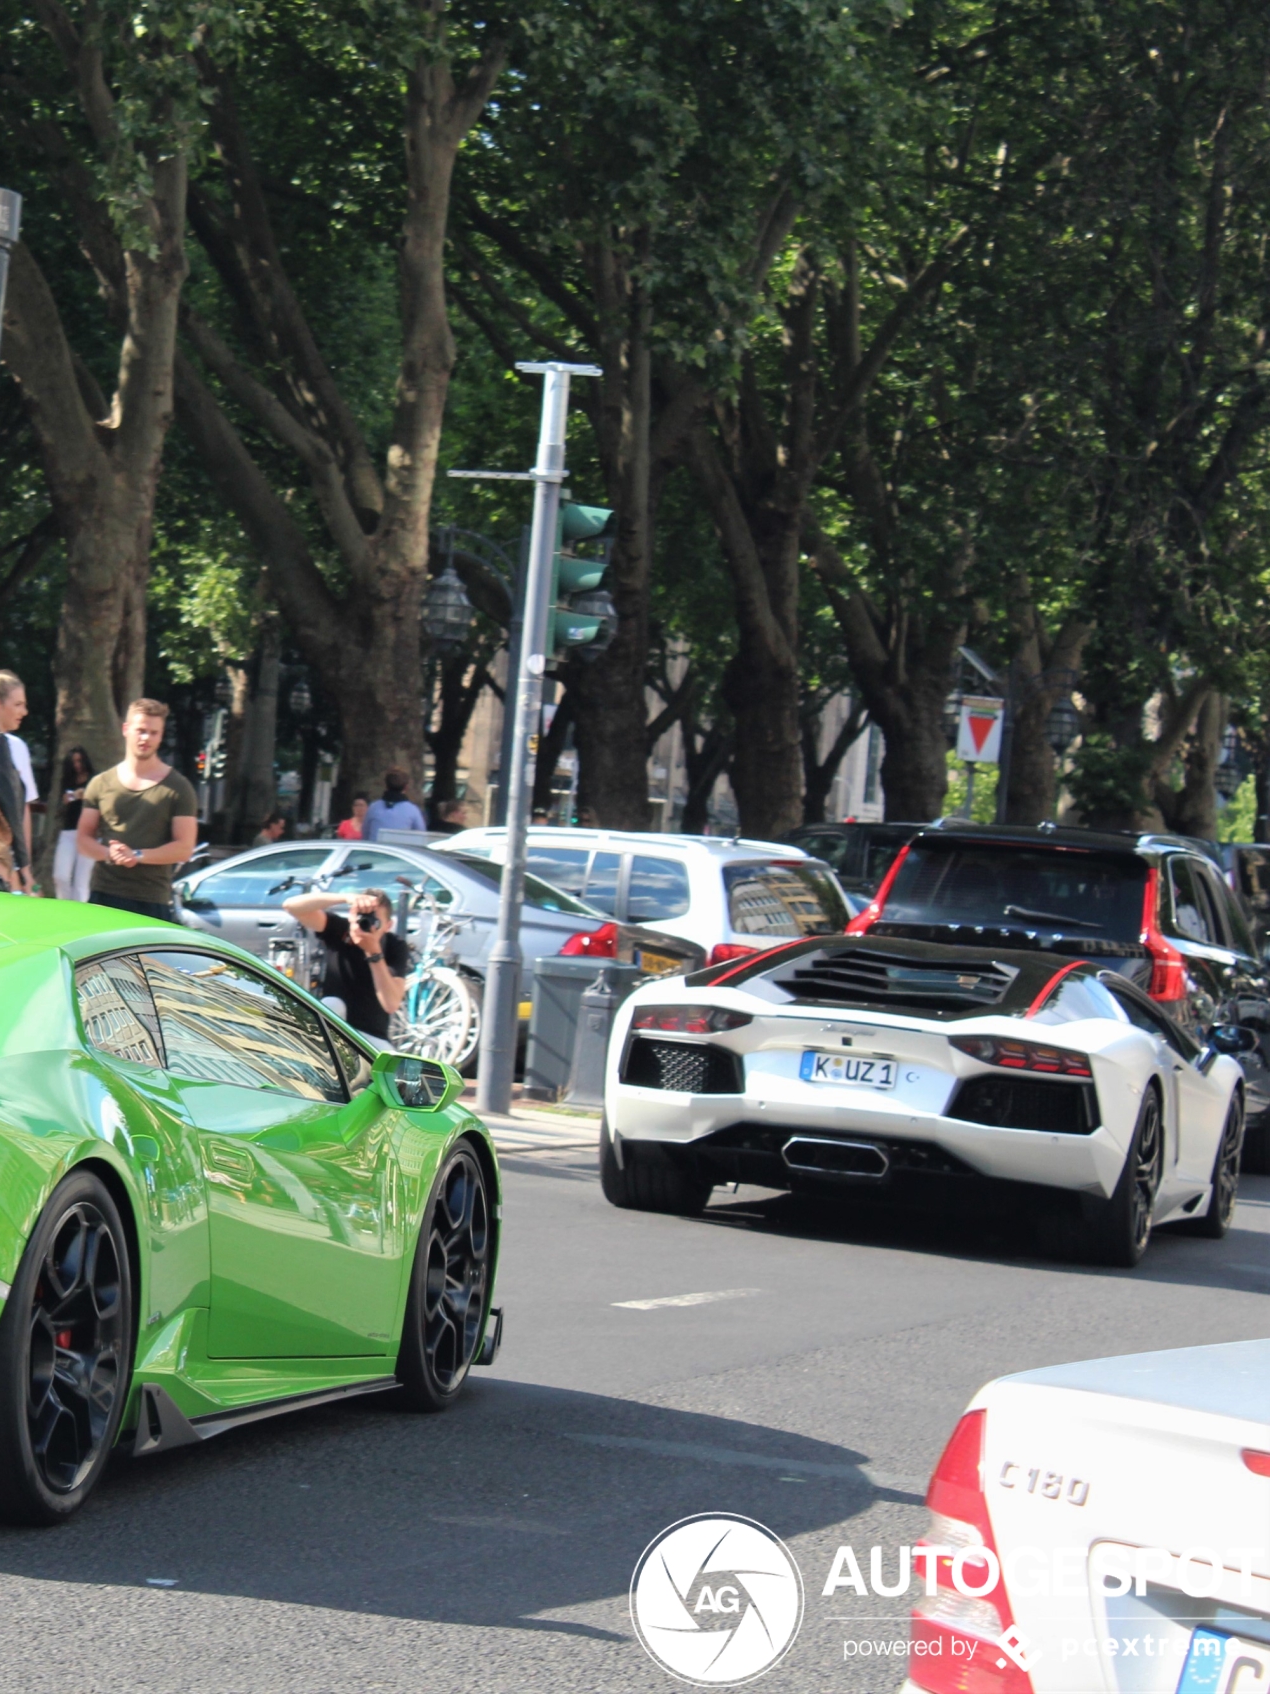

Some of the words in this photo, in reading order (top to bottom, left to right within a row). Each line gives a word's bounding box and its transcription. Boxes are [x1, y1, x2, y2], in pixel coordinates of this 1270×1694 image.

[815, 1057, 831, 1078] K
[846, 1060, 875, 1082] UZ
[880, 1064, 892, 1085] 1
